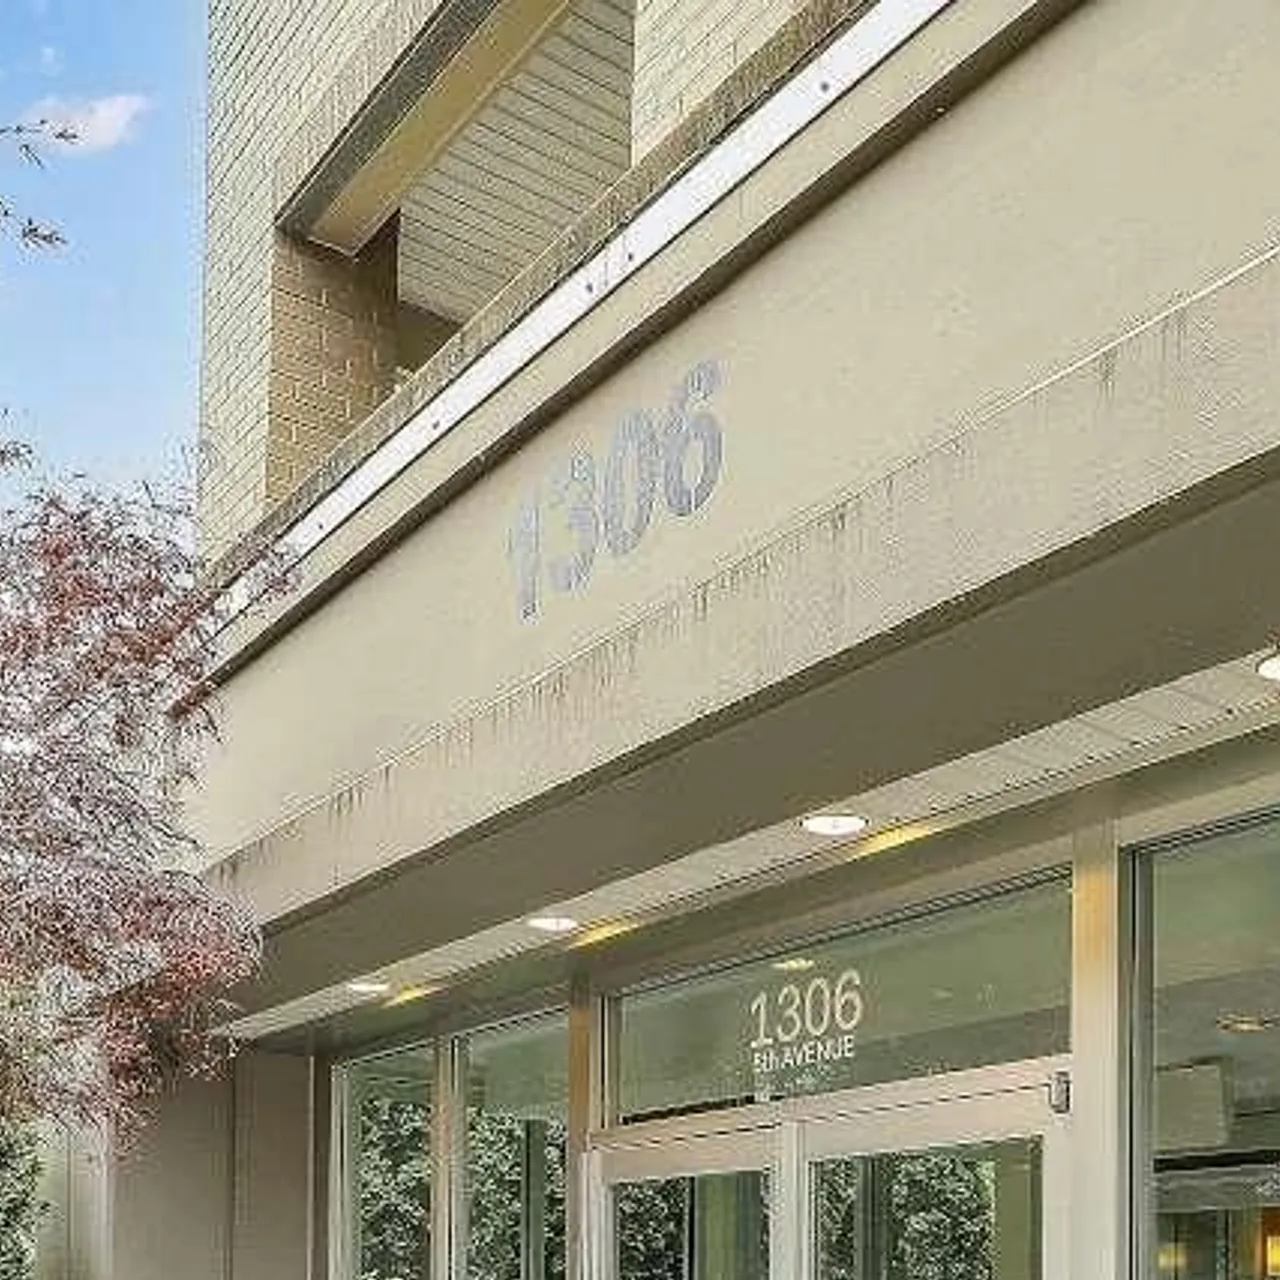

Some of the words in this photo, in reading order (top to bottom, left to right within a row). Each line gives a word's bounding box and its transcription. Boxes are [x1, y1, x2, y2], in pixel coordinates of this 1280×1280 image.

[506, 357, 723, 621] 1306
[751, 969, 862, 1048] 1306
[780, 1034, 855, 1070] AVENUE
